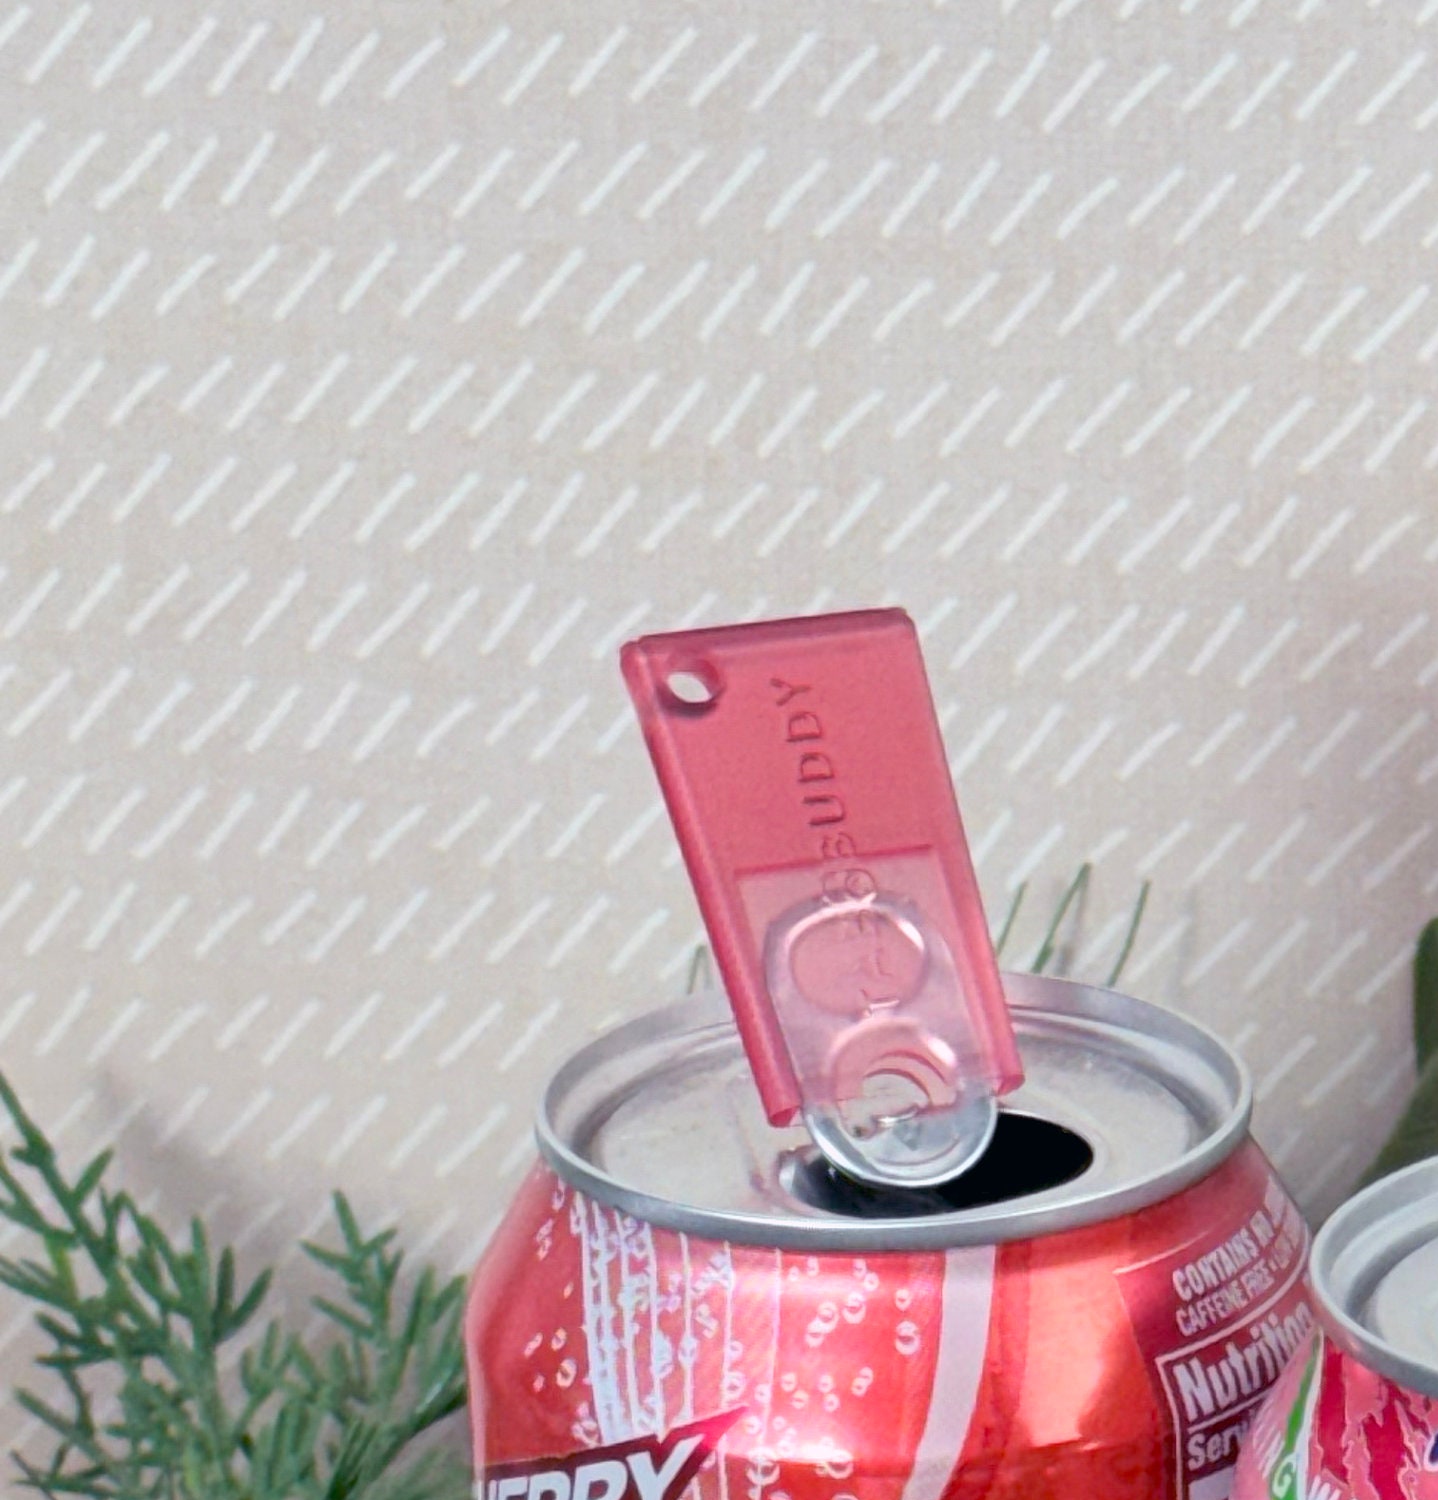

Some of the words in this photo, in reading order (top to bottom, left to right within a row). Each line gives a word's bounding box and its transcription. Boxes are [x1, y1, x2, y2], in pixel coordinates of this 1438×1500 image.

[1172, 1227, 1259, 1301] CONTAINS
[1175, 1280, 1249, 1337] CAFFEINE
[1172, 1301, 1312, 1422] Nutrition
